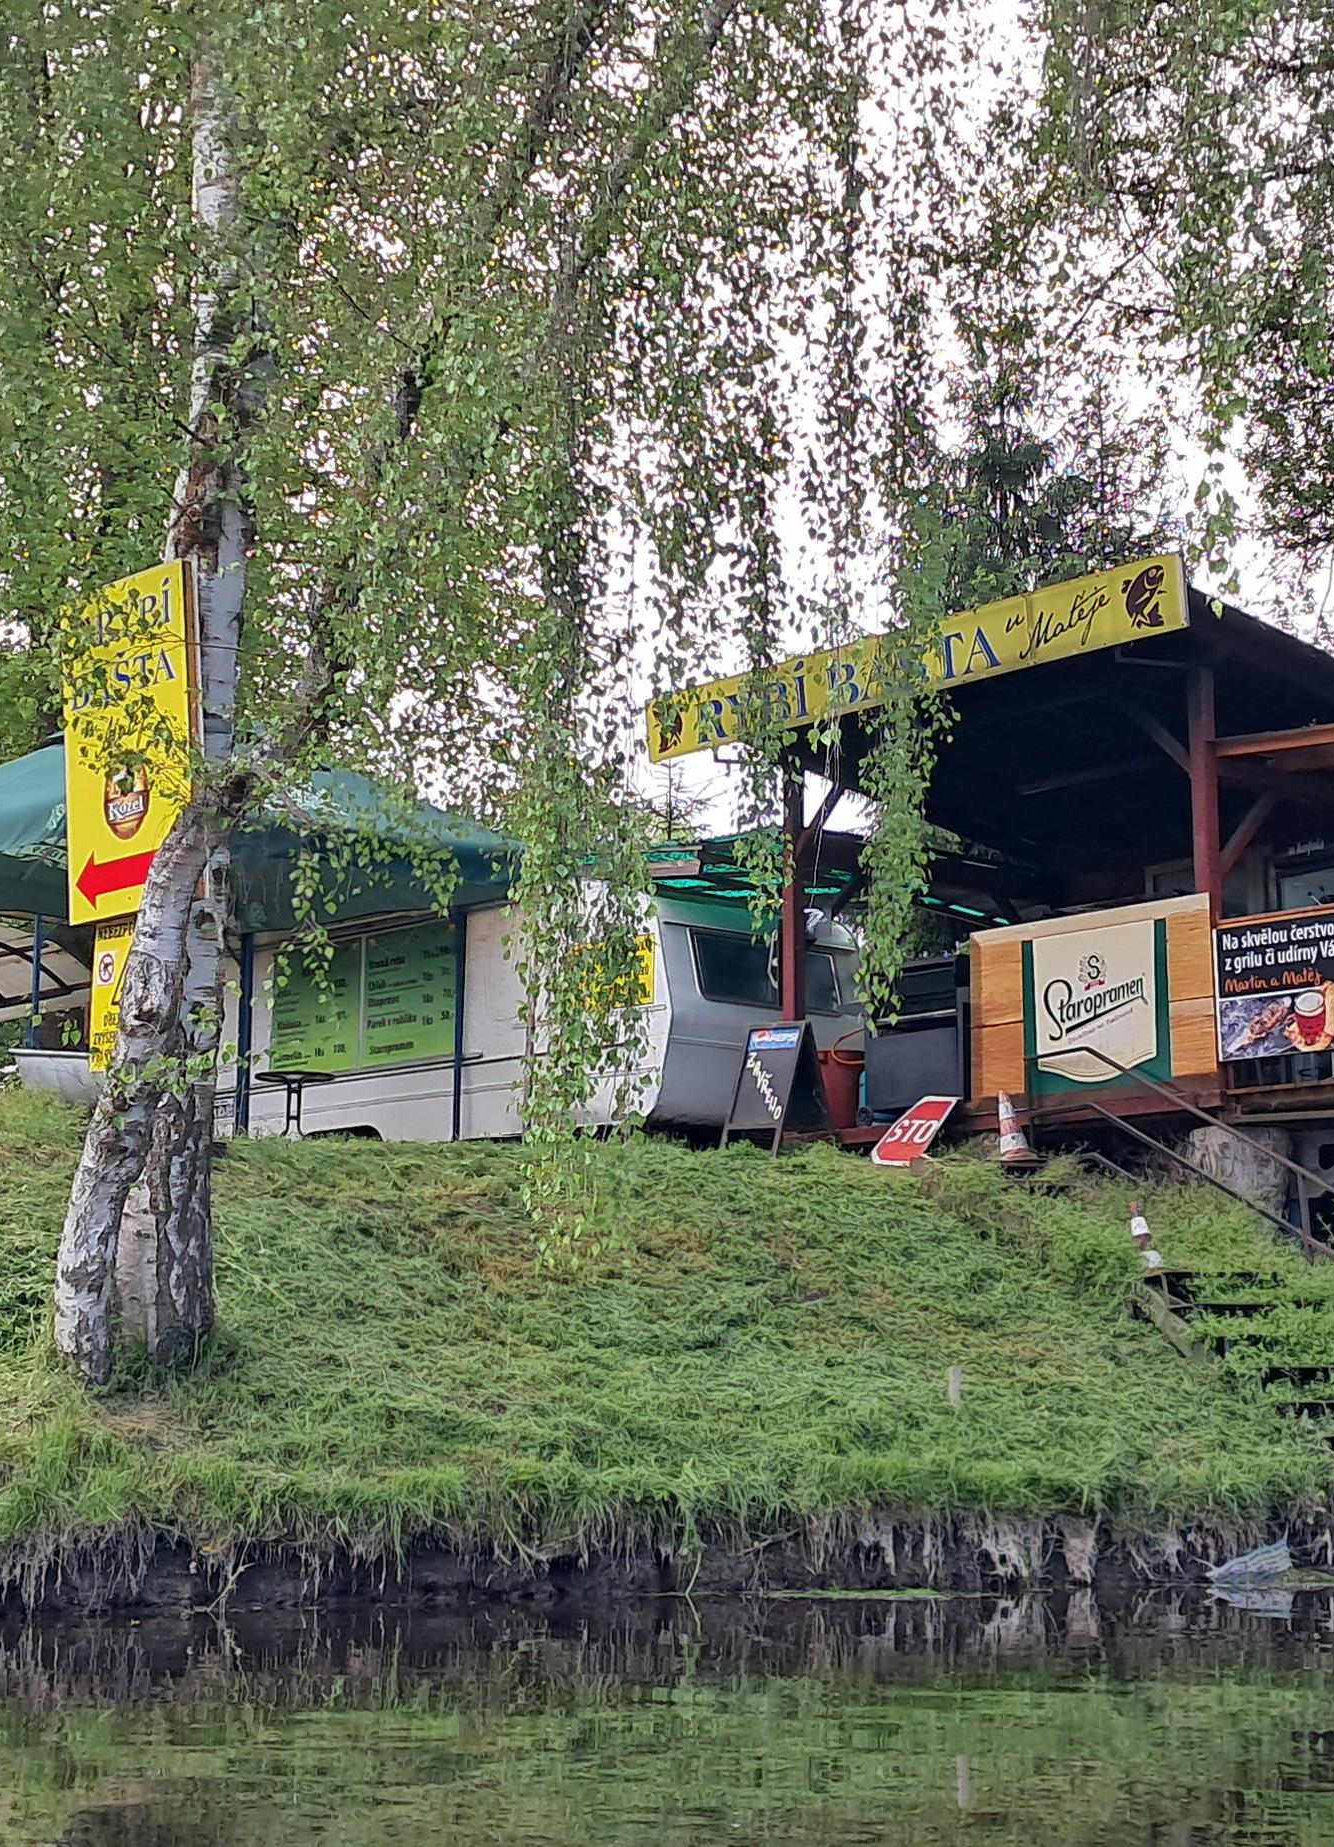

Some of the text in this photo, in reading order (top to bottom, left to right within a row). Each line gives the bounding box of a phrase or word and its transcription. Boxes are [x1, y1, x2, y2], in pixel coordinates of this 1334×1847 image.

[826, 626, 1002, 704] BTA
[1019, 585, 1111, 660] Matěje
[70, 647, 176, 713] BŠTA
[107, 794, 145, 822] Kozel
[1222, 933, 1239, 950] Na
[1241, 927, 1287, 949] skvělou
[1224, 957, 1232, 971] z
[1234, 952, 1263, 974] grilu
[1265, 947, 1275, 965] či
[1277, 945, 1317, 964] udírny
[1224, 967, 1325, 992] Martin a Matěj
[1043, 977, 1149, 1041] Staropramen
[746, 1052, 782, 1121] ZAVŘENO
